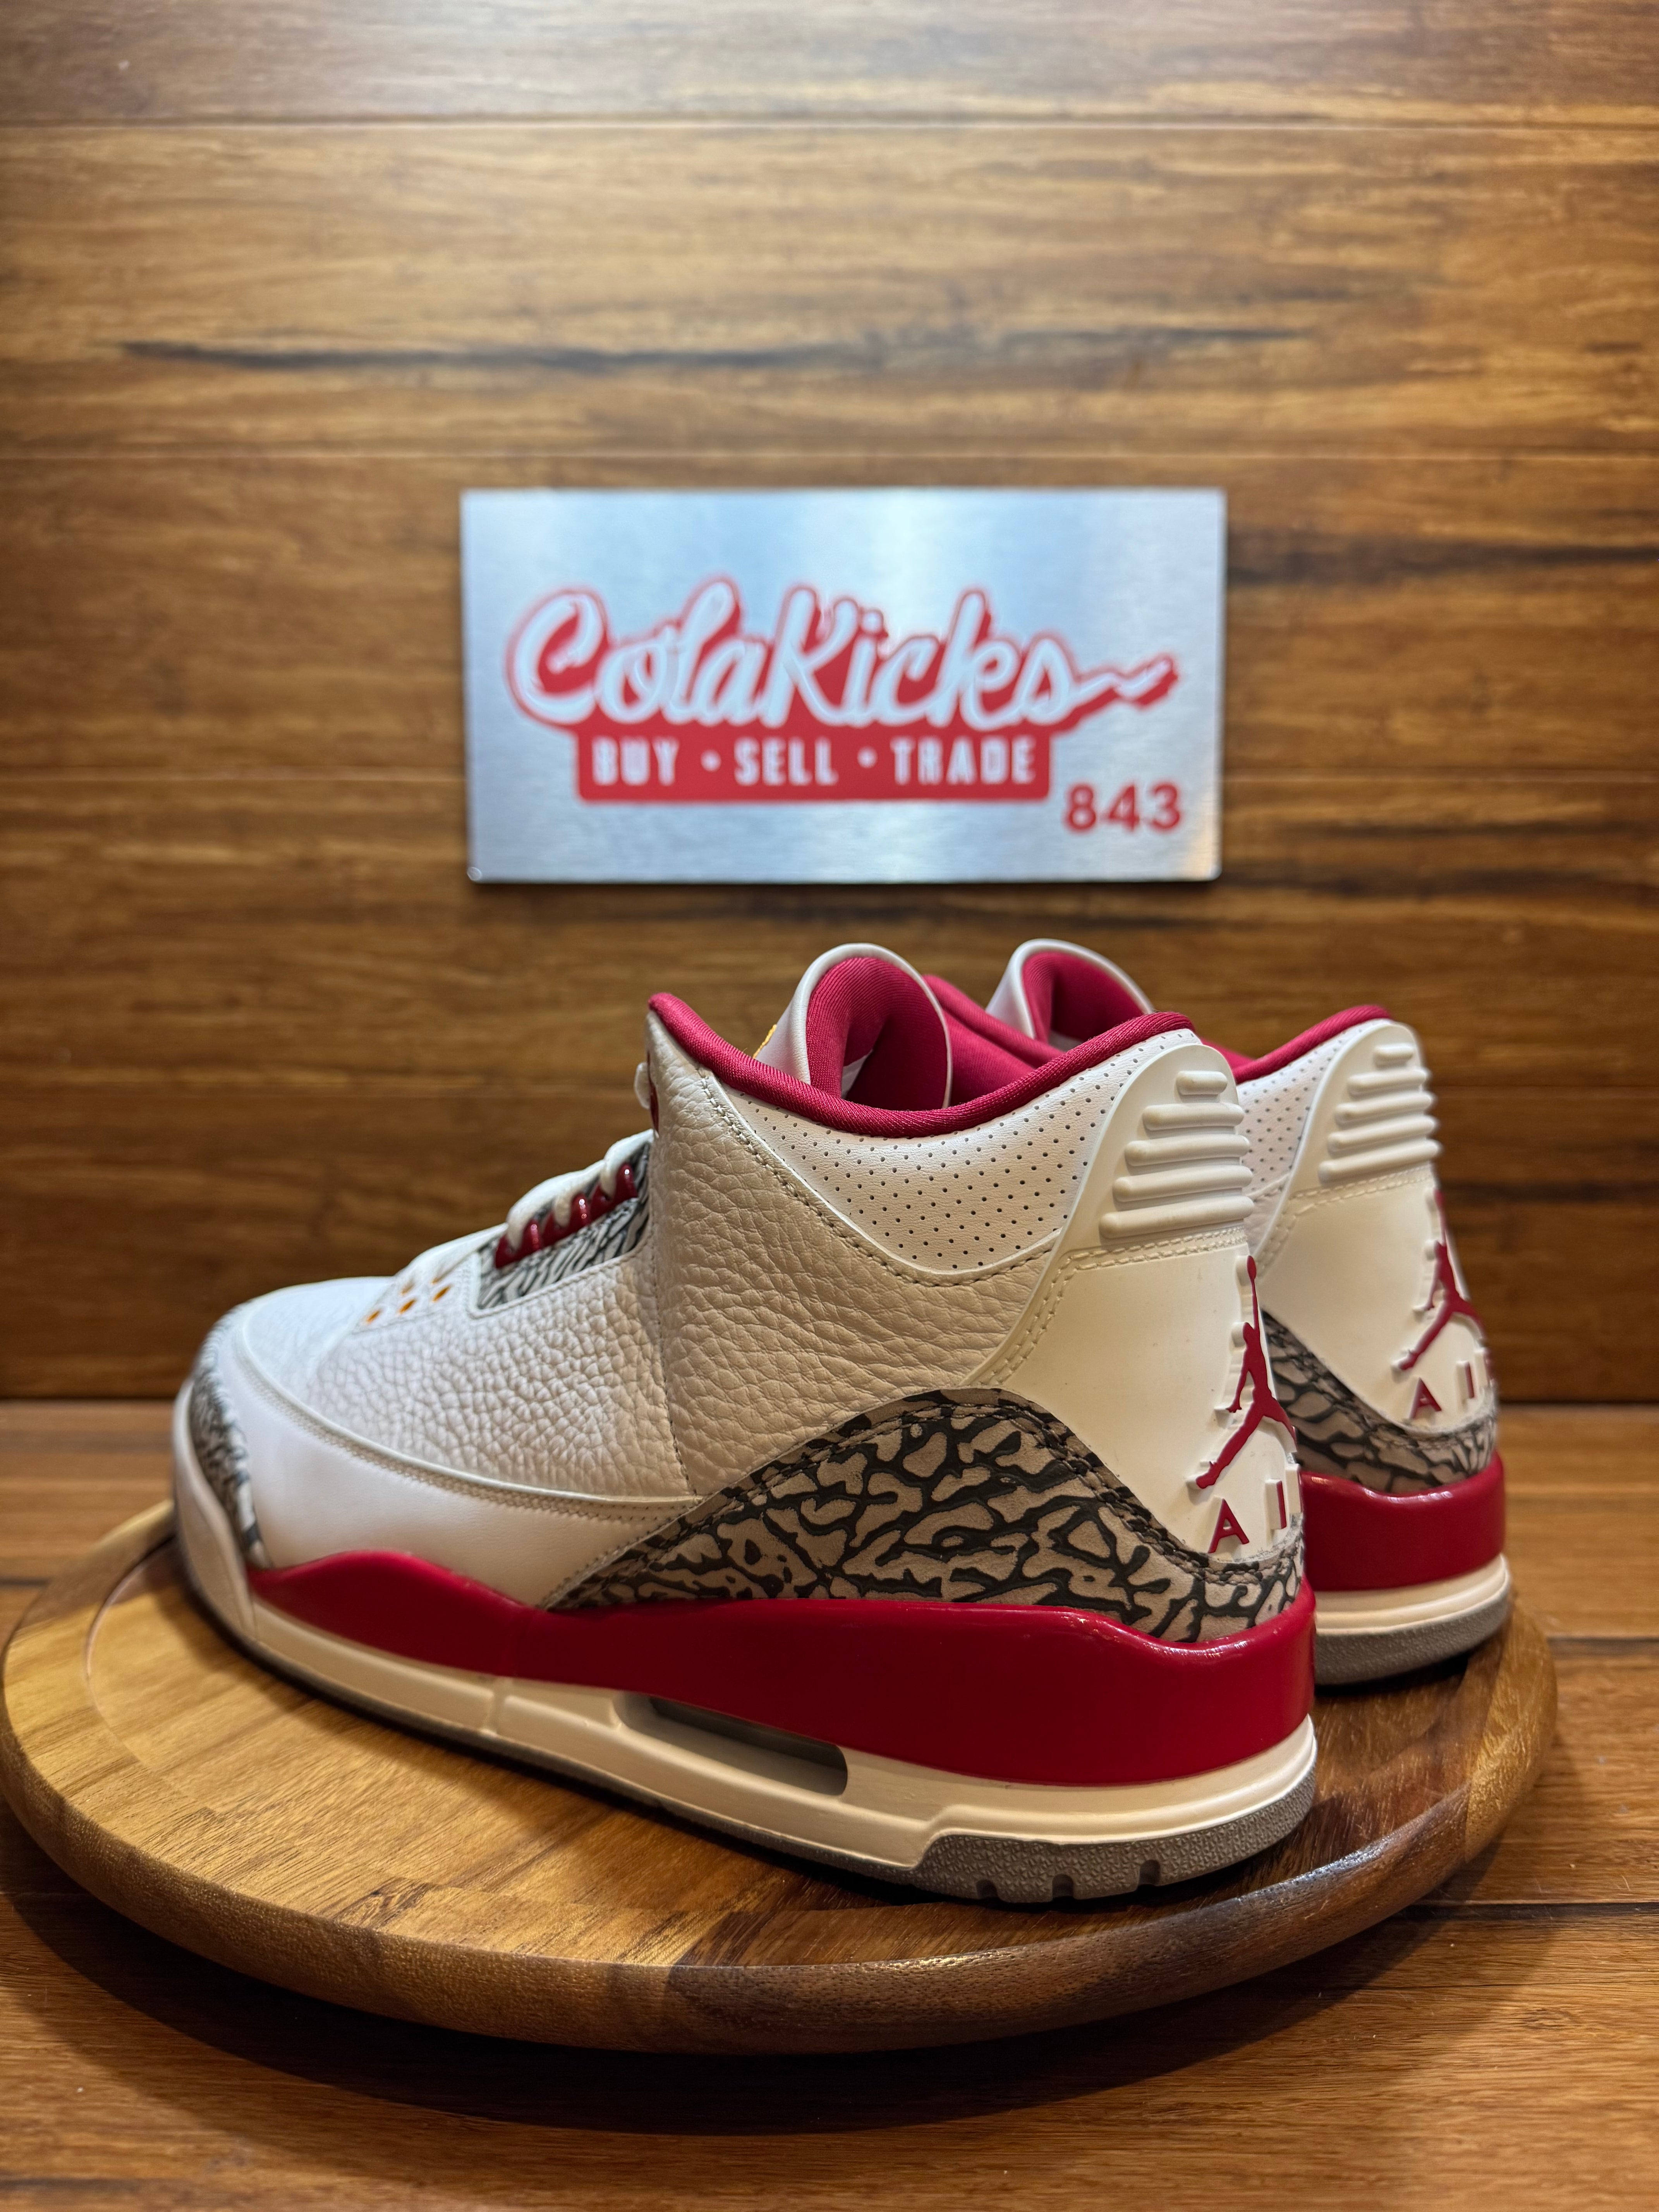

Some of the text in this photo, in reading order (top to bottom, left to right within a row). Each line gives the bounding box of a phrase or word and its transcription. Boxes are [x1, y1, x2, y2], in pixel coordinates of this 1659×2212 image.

[507, 575, 1178, 729] ColaKicks
[592, 735, 1036, 787] BUY SELL TRADE
[1066, 782, 1182, 832] 843
[1410, 1349, 1494, 1420] AI
[1207, 1463, 1303, 1554] AI
